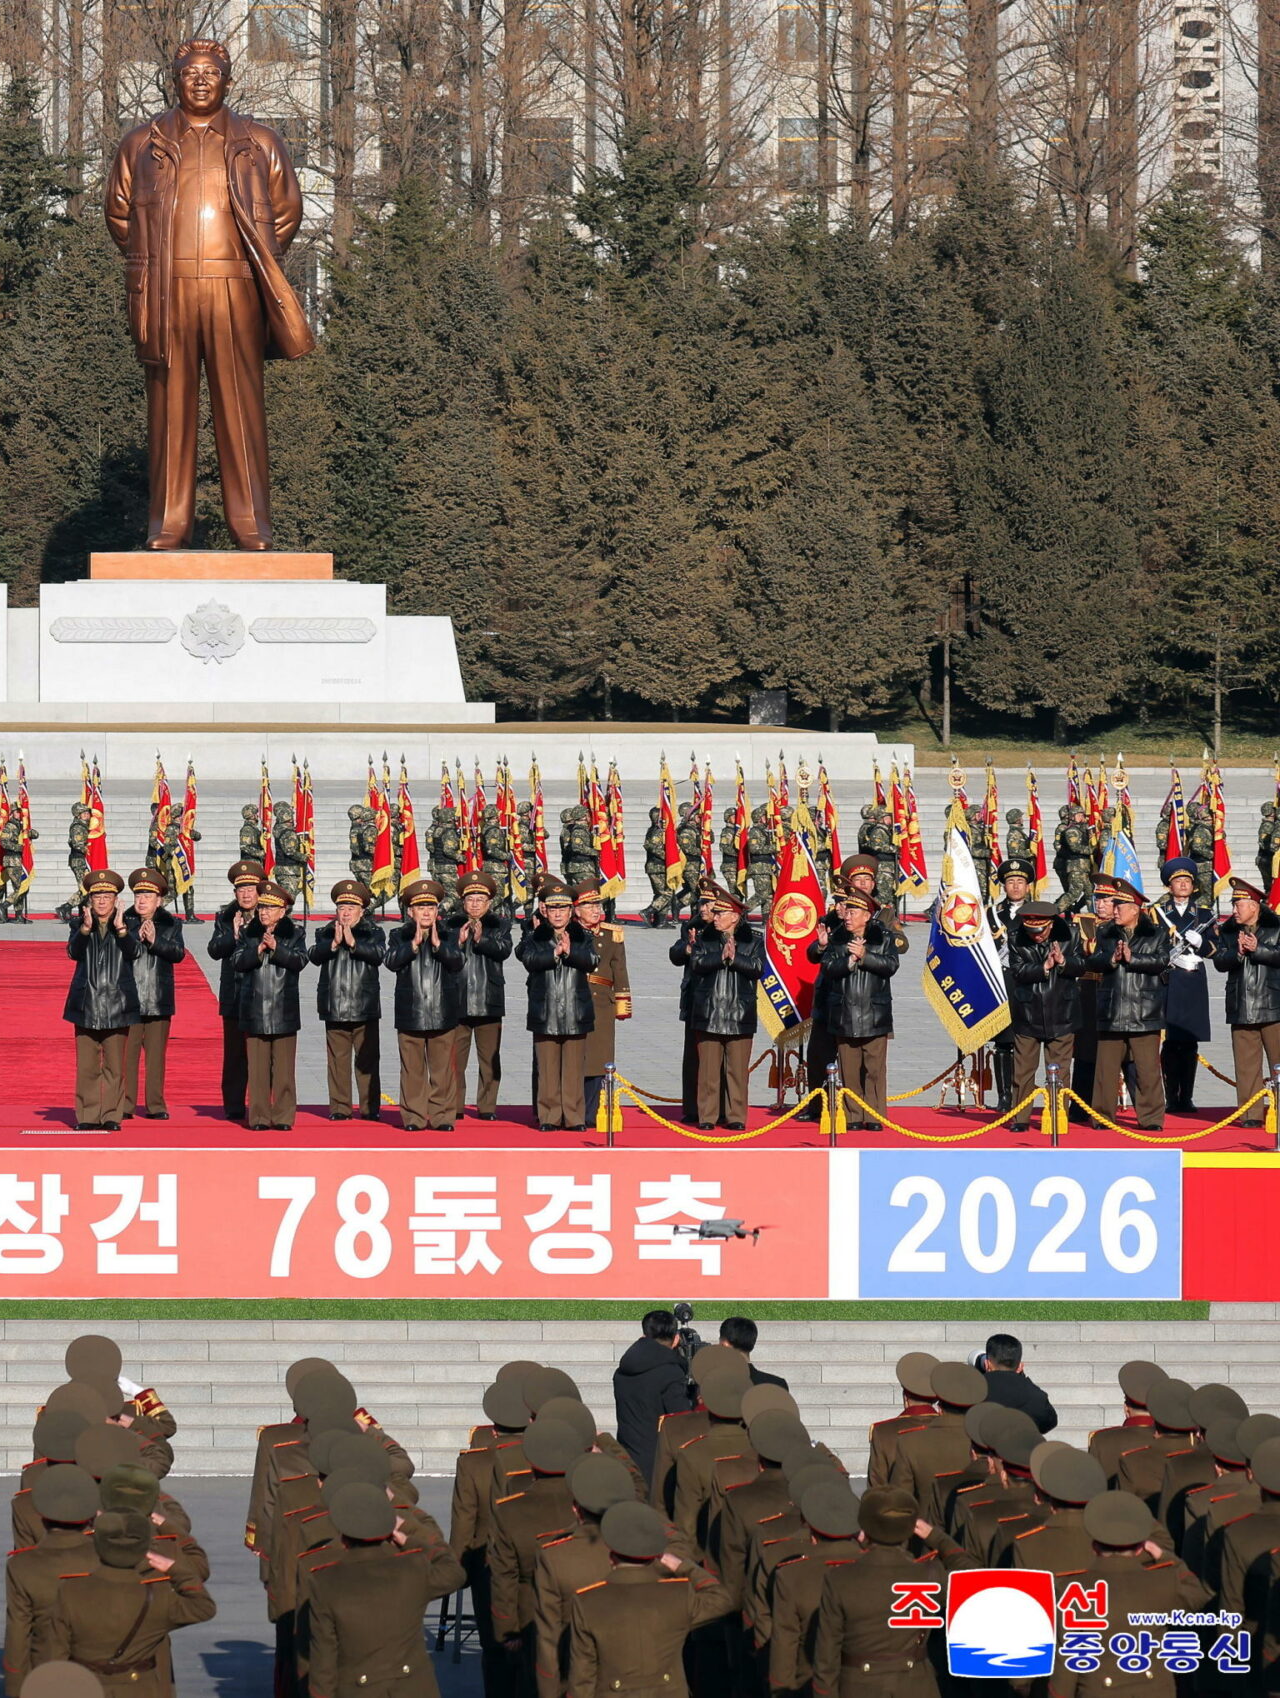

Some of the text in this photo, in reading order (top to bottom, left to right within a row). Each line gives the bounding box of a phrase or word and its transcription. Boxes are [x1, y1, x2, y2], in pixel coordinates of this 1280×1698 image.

[763, 974, 794, 1019] 위하여
[941, 975, 974, 1018] 위하여
[257, 1173, 727, 1280] 78돐경축
[886, 1175, 1158, 1274] 2026
